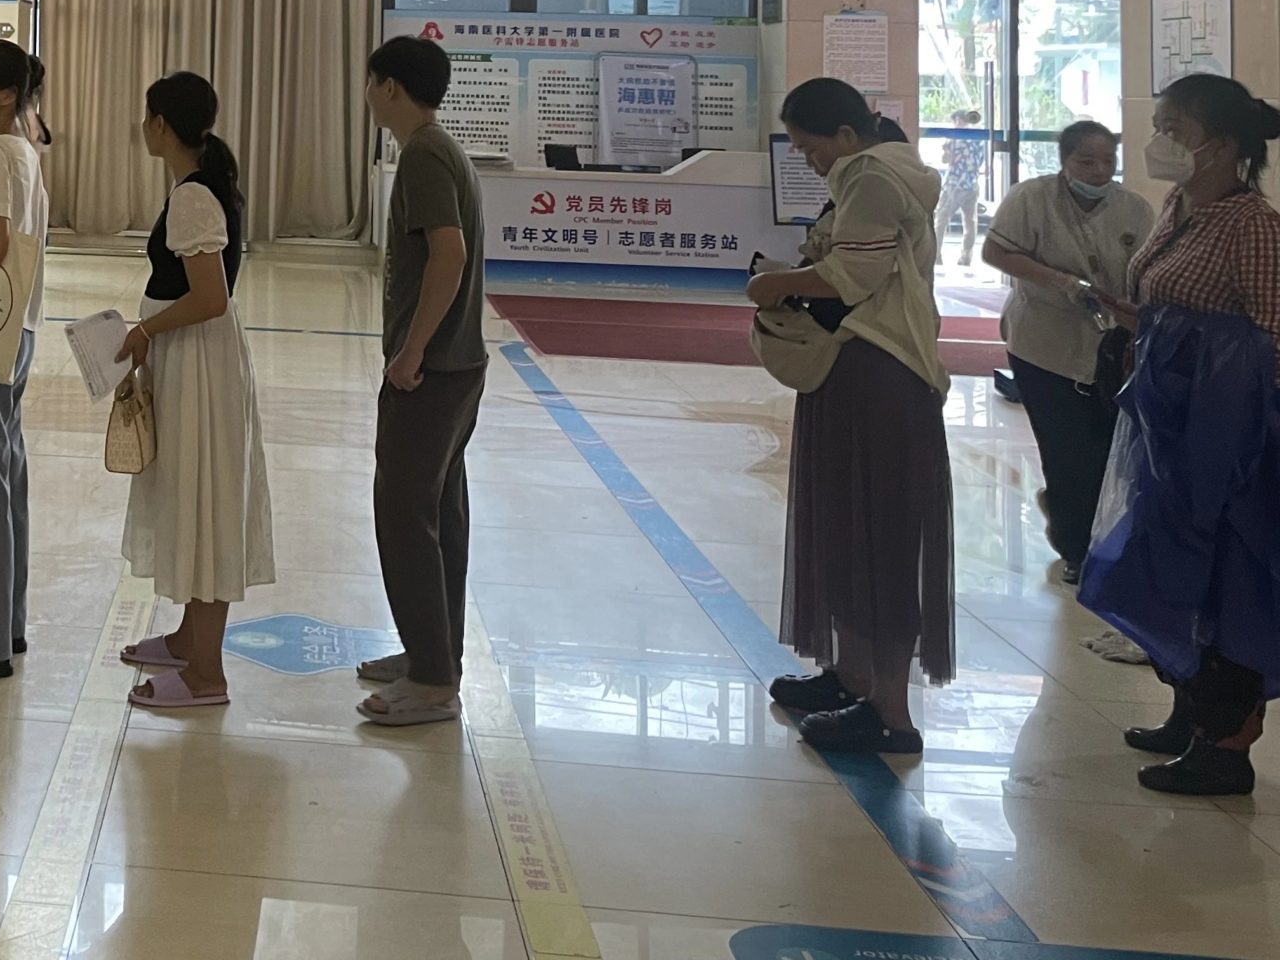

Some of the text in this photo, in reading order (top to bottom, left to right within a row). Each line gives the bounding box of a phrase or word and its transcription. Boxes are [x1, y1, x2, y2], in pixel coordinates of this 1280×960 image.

[454, 24, 622, 39] 海南医科大学第一附属医院
[617, 87, 676, 106] 海惠帮
[565, 194, 673, 216] 党员先锋岗
[573, 216, 658, 226] CPC Member Position
[502, 226, 739, 251] 青年文明号 志愿者服务站
[532, 245, 571, 253] Civilization
[665, 250, 691, 258] Service
